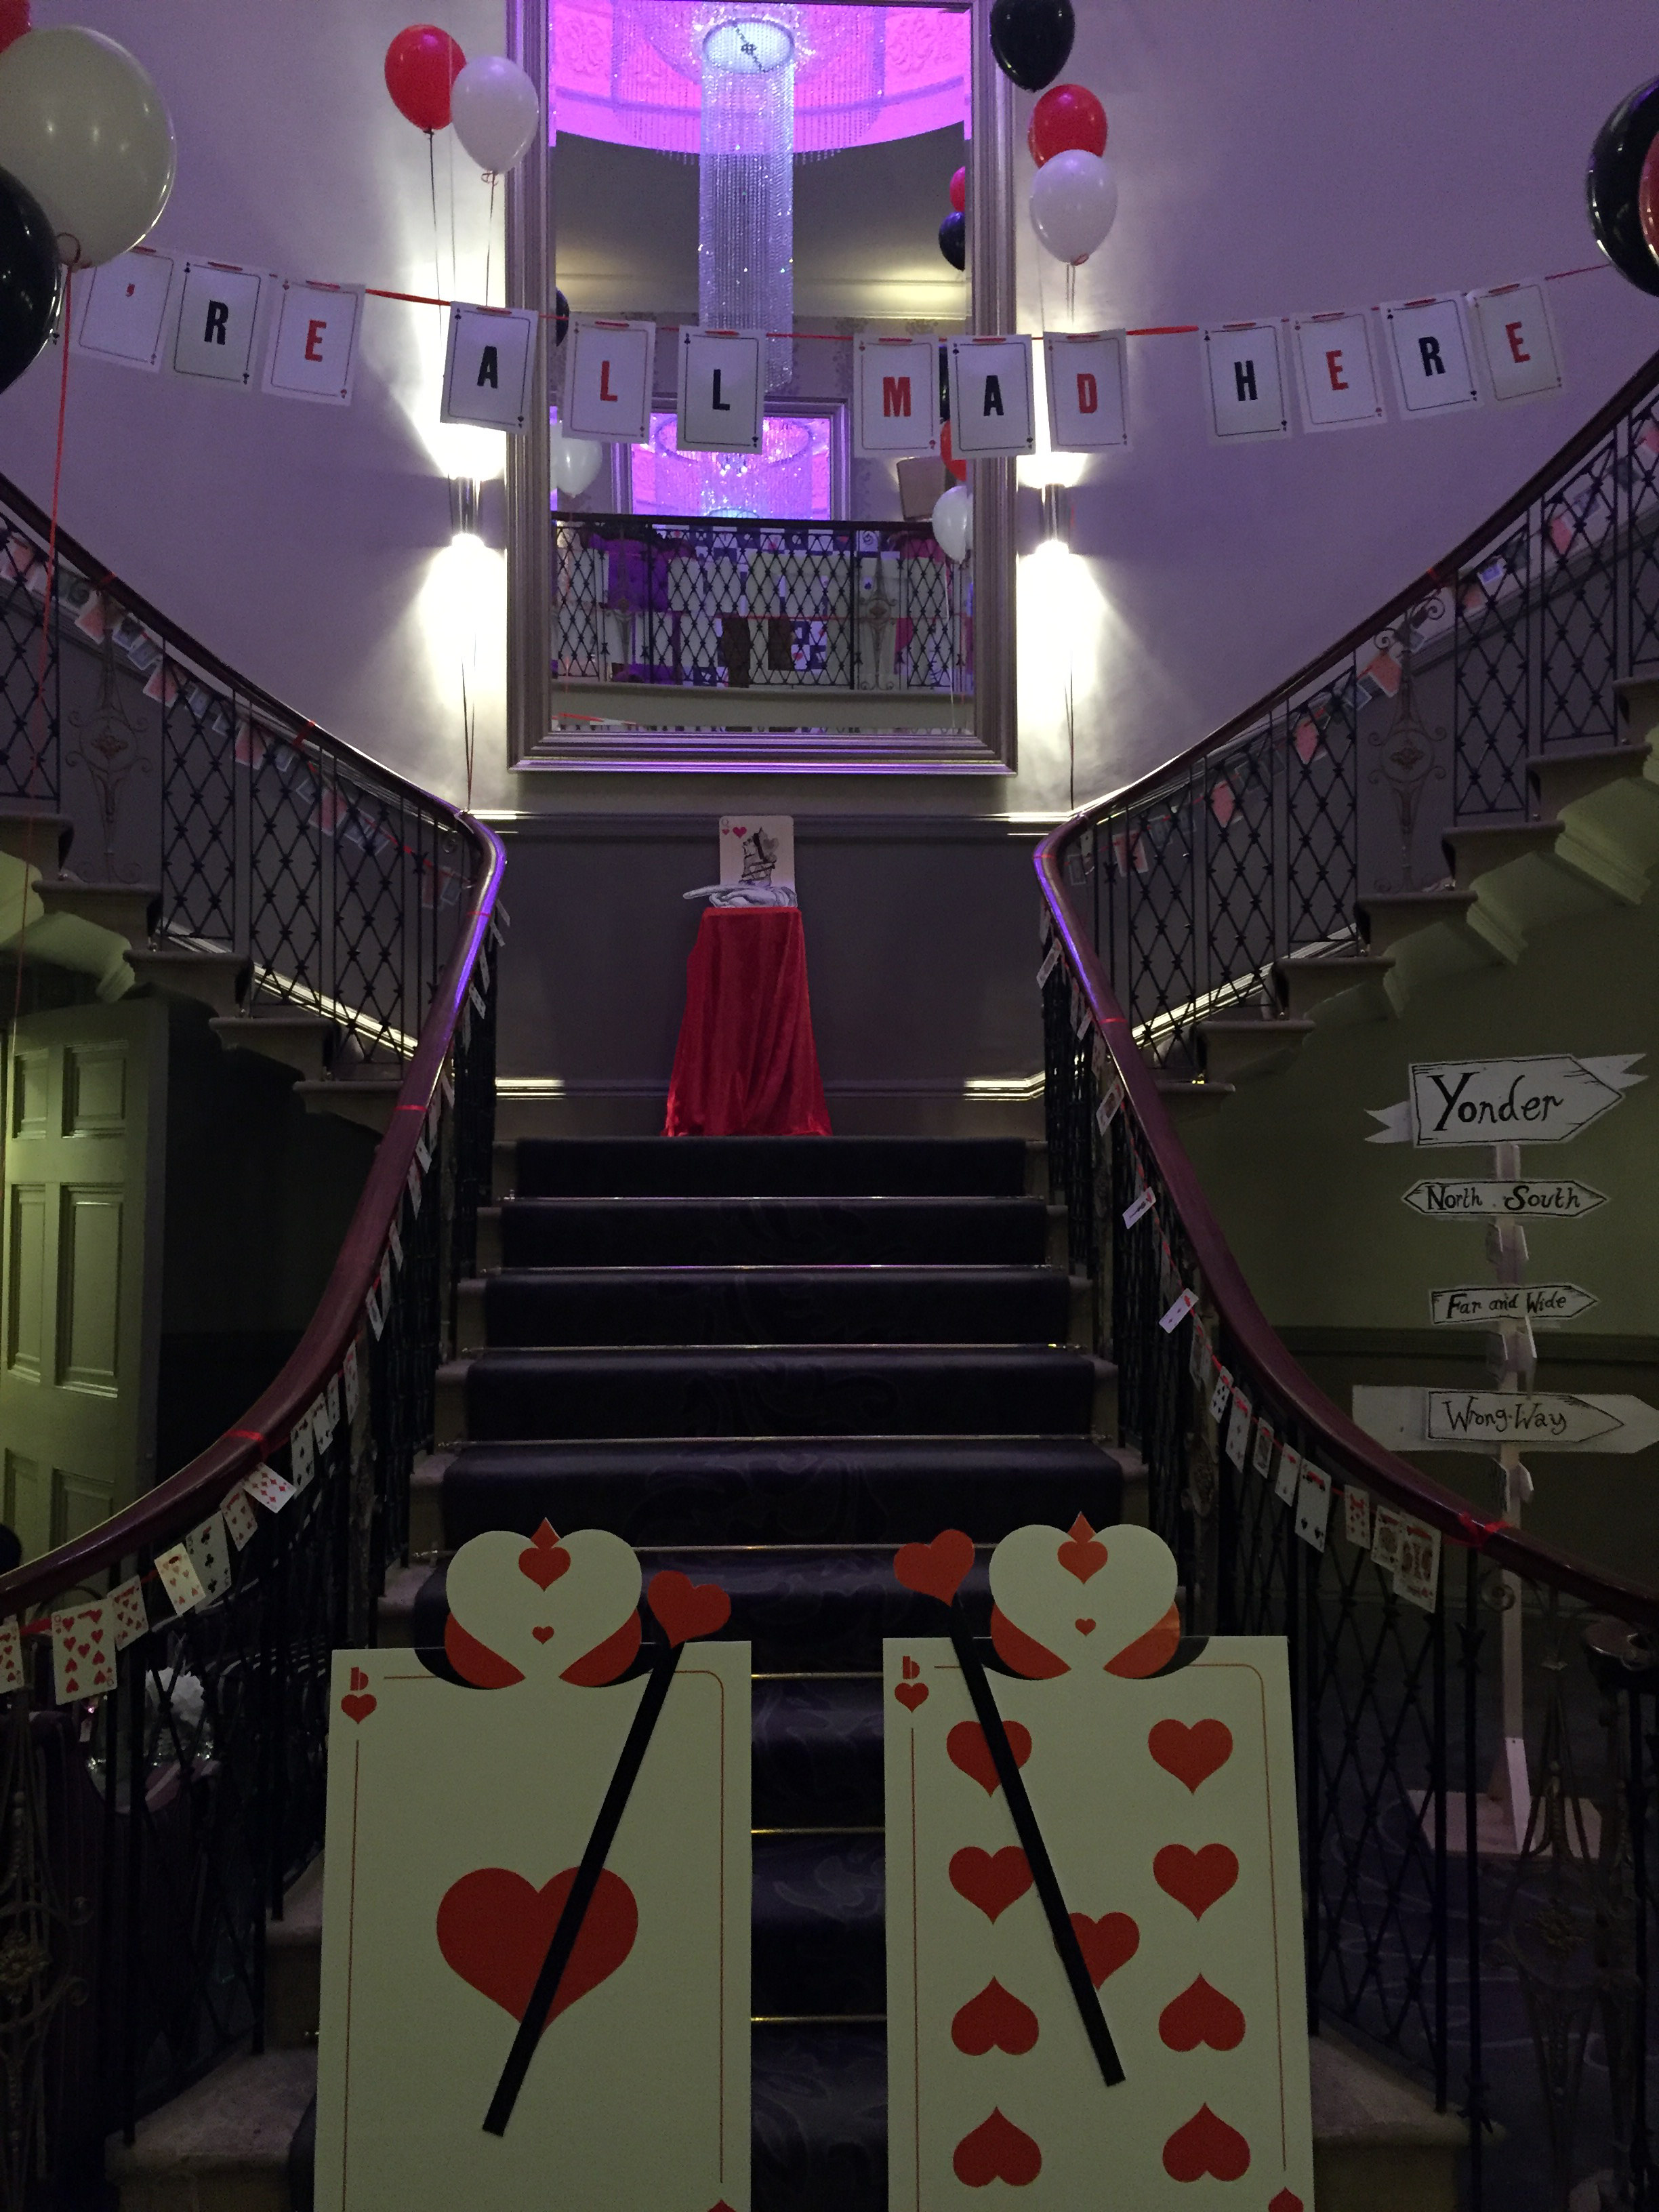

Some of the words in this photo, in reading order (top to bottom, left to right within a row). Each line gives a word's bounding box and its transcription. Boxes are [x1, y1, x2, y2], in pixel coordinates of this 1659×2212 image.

[476, 346, 730, 411] ALL
[883, 373, 1098, 418] MAD
[1234, 321, 1530, 401] HERE
[1427, 1071, 1564, 1131] Yonder
[1425, 1185, 1483, 1210] North
[1503, 1185, 1580, 1210] South
[1446, 1293, 1482, 1318] Far
[1489, 1293, 1519, 1311] and
[1526, 1290, 1567, 1313] Wide
[1441, 1395, 1508, 1432] Wrong
[1515, 1403, 1566, 1435] Way
